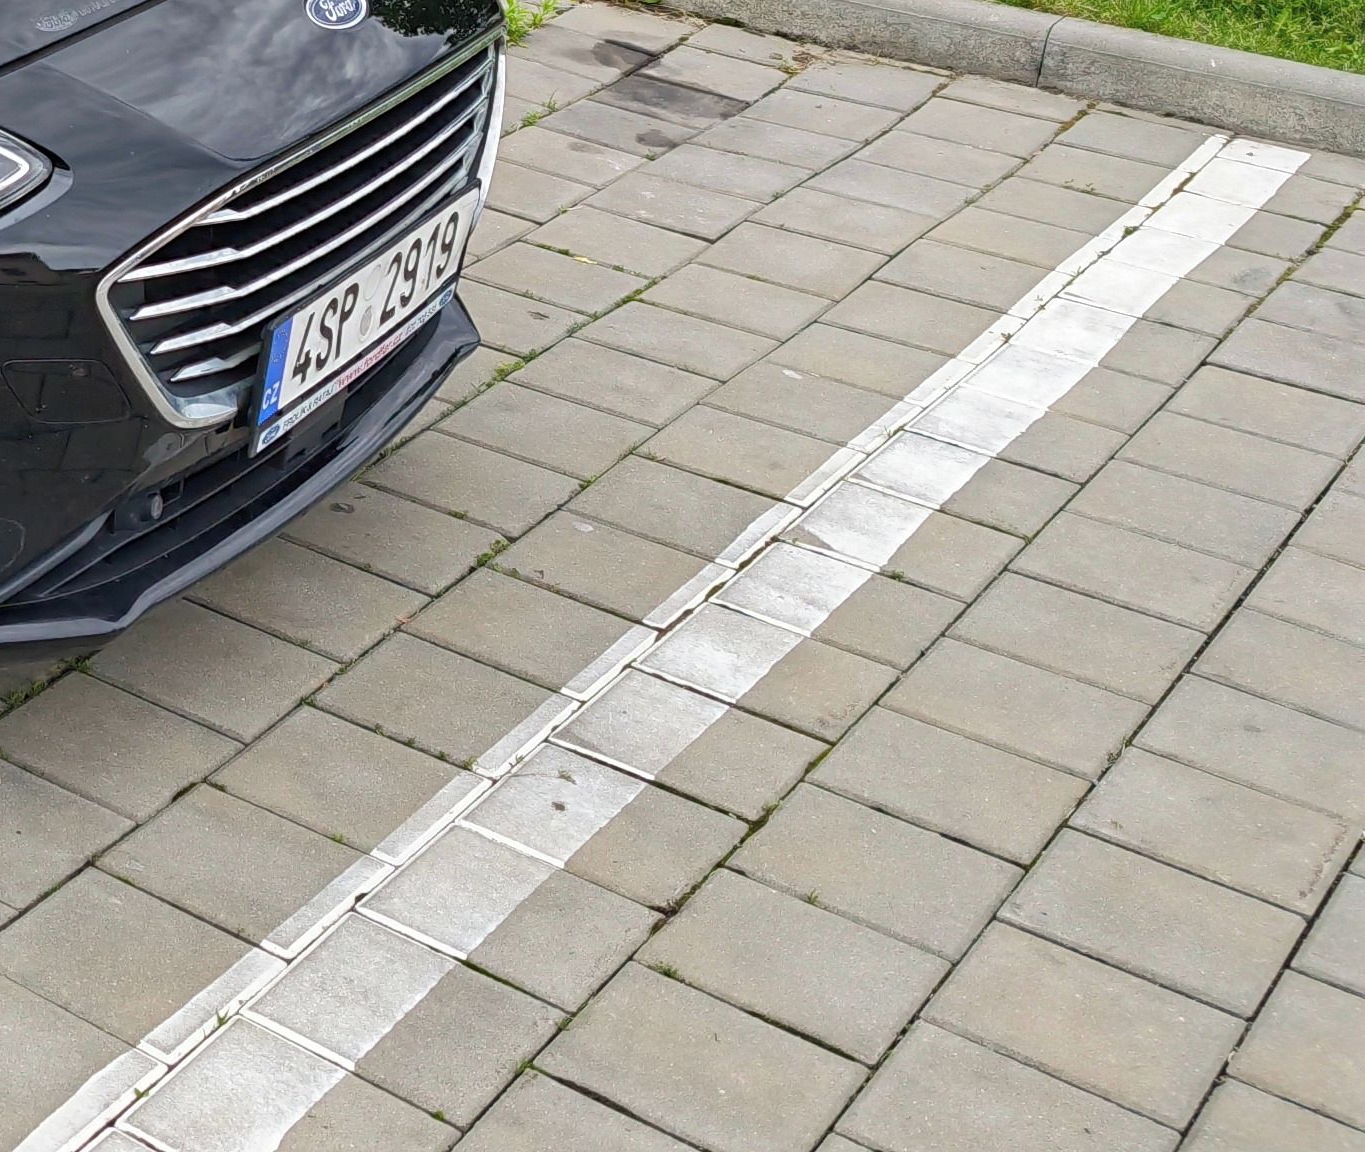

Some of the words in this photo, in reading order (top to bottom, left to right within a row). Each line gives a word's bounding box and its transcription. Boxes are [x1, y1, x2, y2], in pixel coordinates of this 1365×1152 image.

[291, 282, 360, 385] 4SP
[379, 211, 460, 328] 2919
[262, 380, 280, 411] CZ
